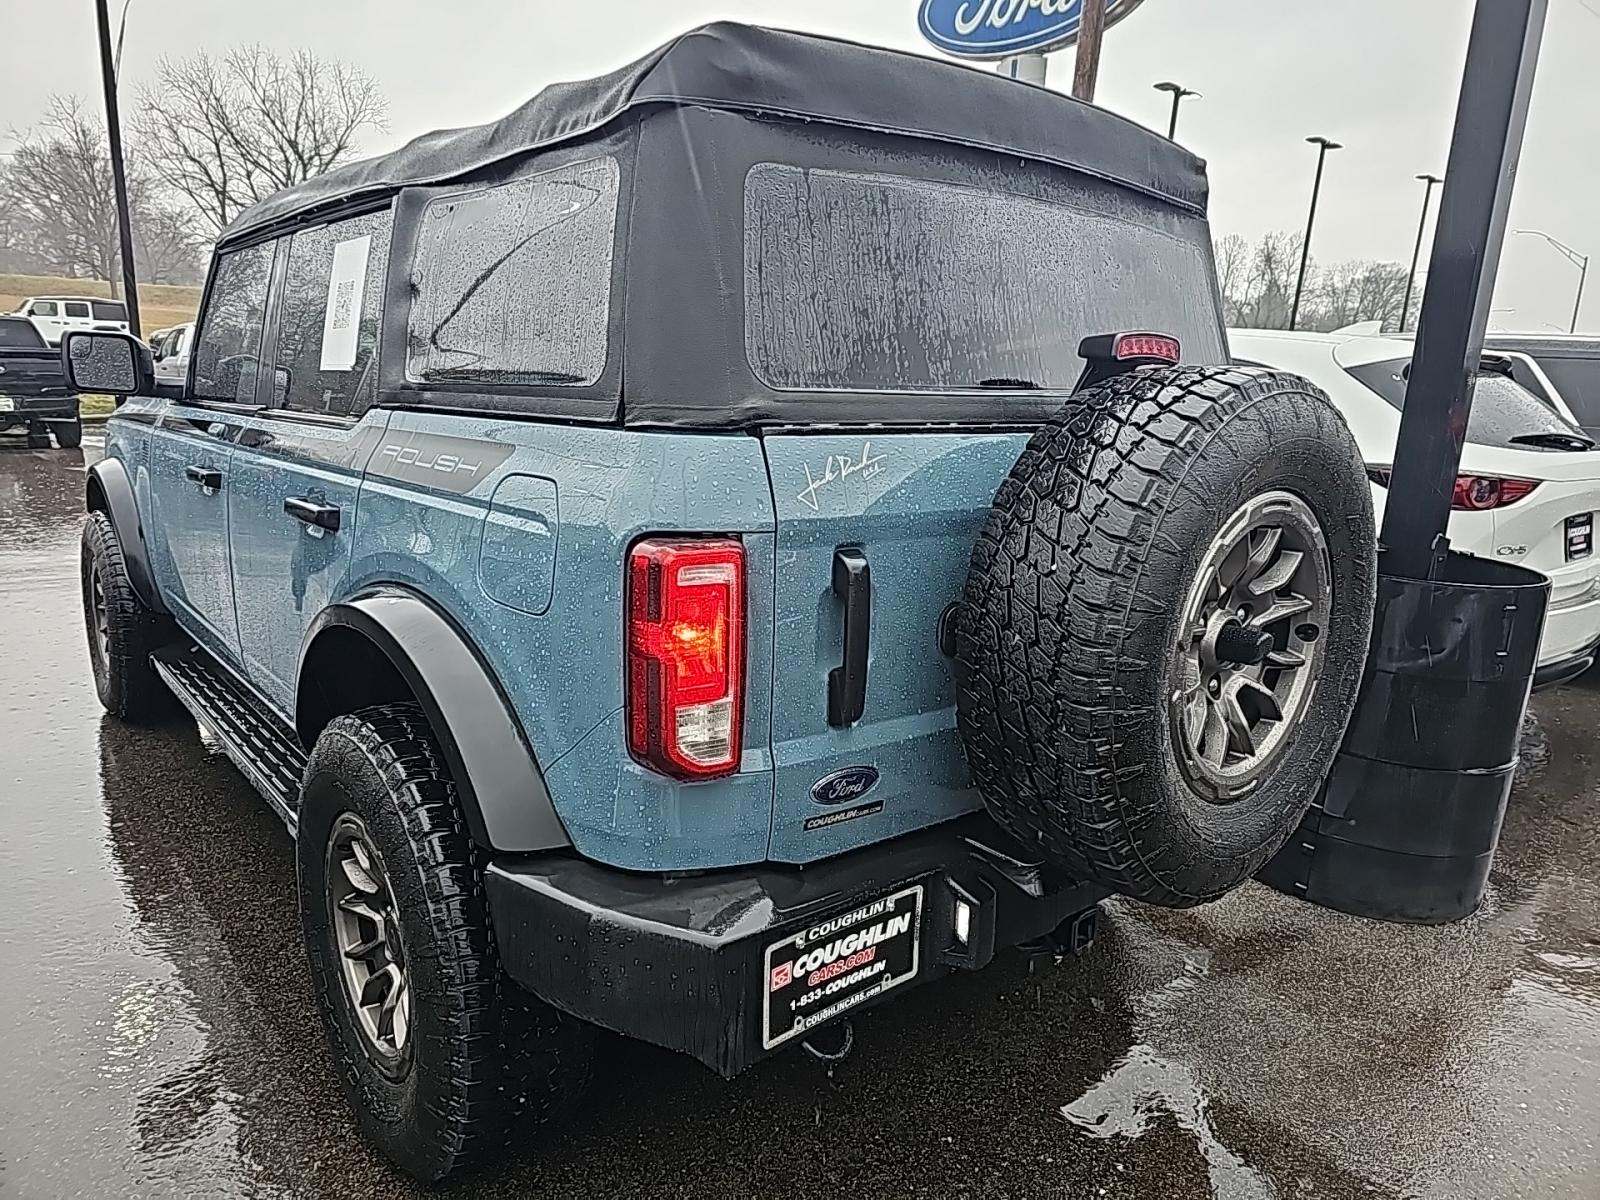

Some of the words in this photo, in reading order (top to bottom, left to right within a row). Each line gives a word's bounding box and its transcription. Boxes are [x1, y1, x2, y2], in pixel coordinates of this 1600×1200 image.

[379, 444, 482, 477] ROUSH
[828, 776, 866, 799] Ford
[808, 900, 885, 940] COUGHLIN
[792, 912, 911, 979] COUGHLIN
[789, 959, 887, 1011] 1-833-COUGHLIN
[807, 946, 876, 987] CARS.COM
